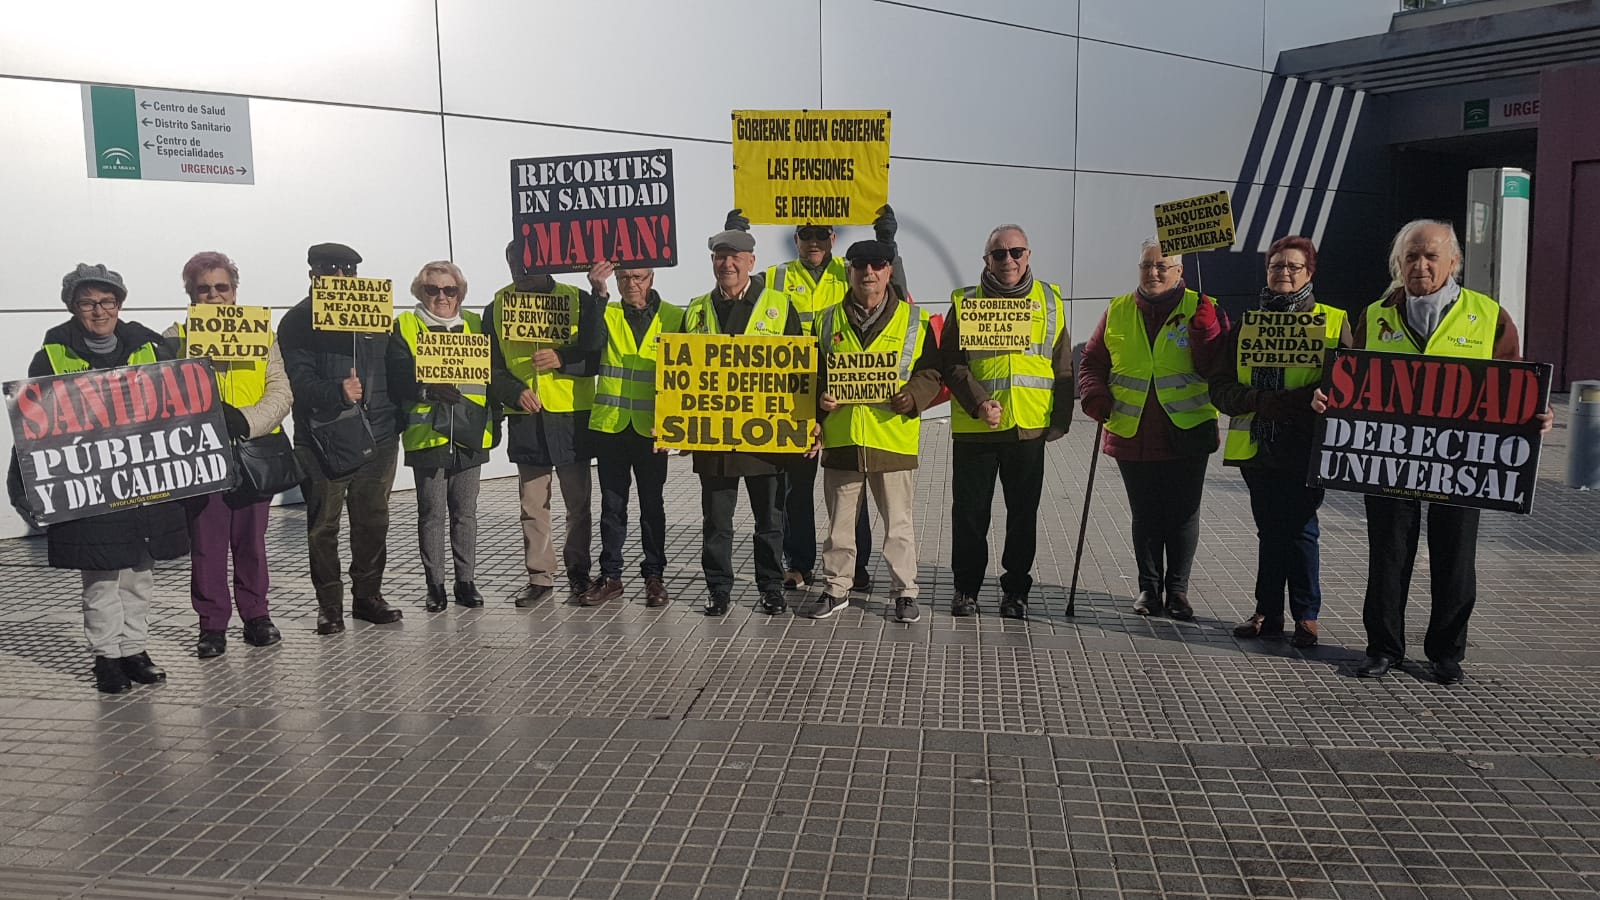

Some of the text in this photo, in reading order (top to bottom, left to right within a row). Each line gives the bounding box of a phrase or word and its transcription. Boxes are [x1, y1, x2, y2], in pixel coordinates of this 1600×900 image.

[154, 102, 225, 116] Centro de Salud
[155, 118, 231, 132] Distrito Sanitario
[737, 118, 885, 142] GOBIERNE QUIEN GOBIERNE
[156, 135, 200, 147] Centro de
[157, 146, 224, 159] Especialidades
[181, 164, 234, 175] URGENCIAS
[518, 155, 667, 187] RECORTES
[768, 158, 854, 181] LAS PENSIONES
[519, 182, 669, 214] EN SANIDAD
[1162, 194, 1218, 213] RESCATAN
[775, 196, 849, 218] SE DEFIENDEN
[1156, 203, 1229, 228] BANQUEROS
[1168, 220, 1220, 236] DESPIDEN
[522, 214, 671, 268] ¡MATAN!
[1160, 228, 1232, 253] ENFERMERAS
[313, 278, 391, 292] EL TRABAJO
[316, 291, 389, 302] ESTABLE
[503, 292, 570, 312] NO AL CIERRE
[216, 306, 243, 318] NOS
[323, 303, 381, 313] MEJORA
[961, 300, 1031, 310] LOS GOBIERNOS
[190, 317, 269, 333] ROBAN
[314, 312, 392, 327] LA SALUD
[503, 310, 570, 325] DE SERVICIOS
[1244, 313, 1325, 326] UNIDOS
[503, 324, 570, 340] Y CAMAS
[978, 323, 1012, 332] DE LAS
[1258, 327, 1307, 337] POR LA
[221, 333, 238, 343] LA
[416, 334, 489, 347] MAS RECURSOS
[960, 333, 1030, 346] FARMACÉUTICAS
[1241, 338, 1323, 351] SANIDAD
[189, 344, 269, 357] SALUD
[416, 346, 489, 358] SANITARIOS
[663, 341, 810, 369] LA PENSIÓN
[1240, 351, 1321, 363] PÚBLICA
[828, 353, 897, 369] SANIDAD
[417, 366, 489, 380] NECESARIOS
[829, 371, 897, 382] DERECHO
[663, 370, 809, 394] NO SE DEFIENDE
[1328, 355, 1539, 425] SANIDAD
[18, 362, 212, 440] SANIDAD
[681, 394, 790, 414] DESDE EL
[662, 414, 808, 448] SILLÓN
[1322, 417, 1530, 467] DERECHO
[30, 423, 223, 481] PÚBLICA
[35, 454, 227, 514] Y DE CALIDAD
[1320, 451, 1524, 503] UNIVERSAL
